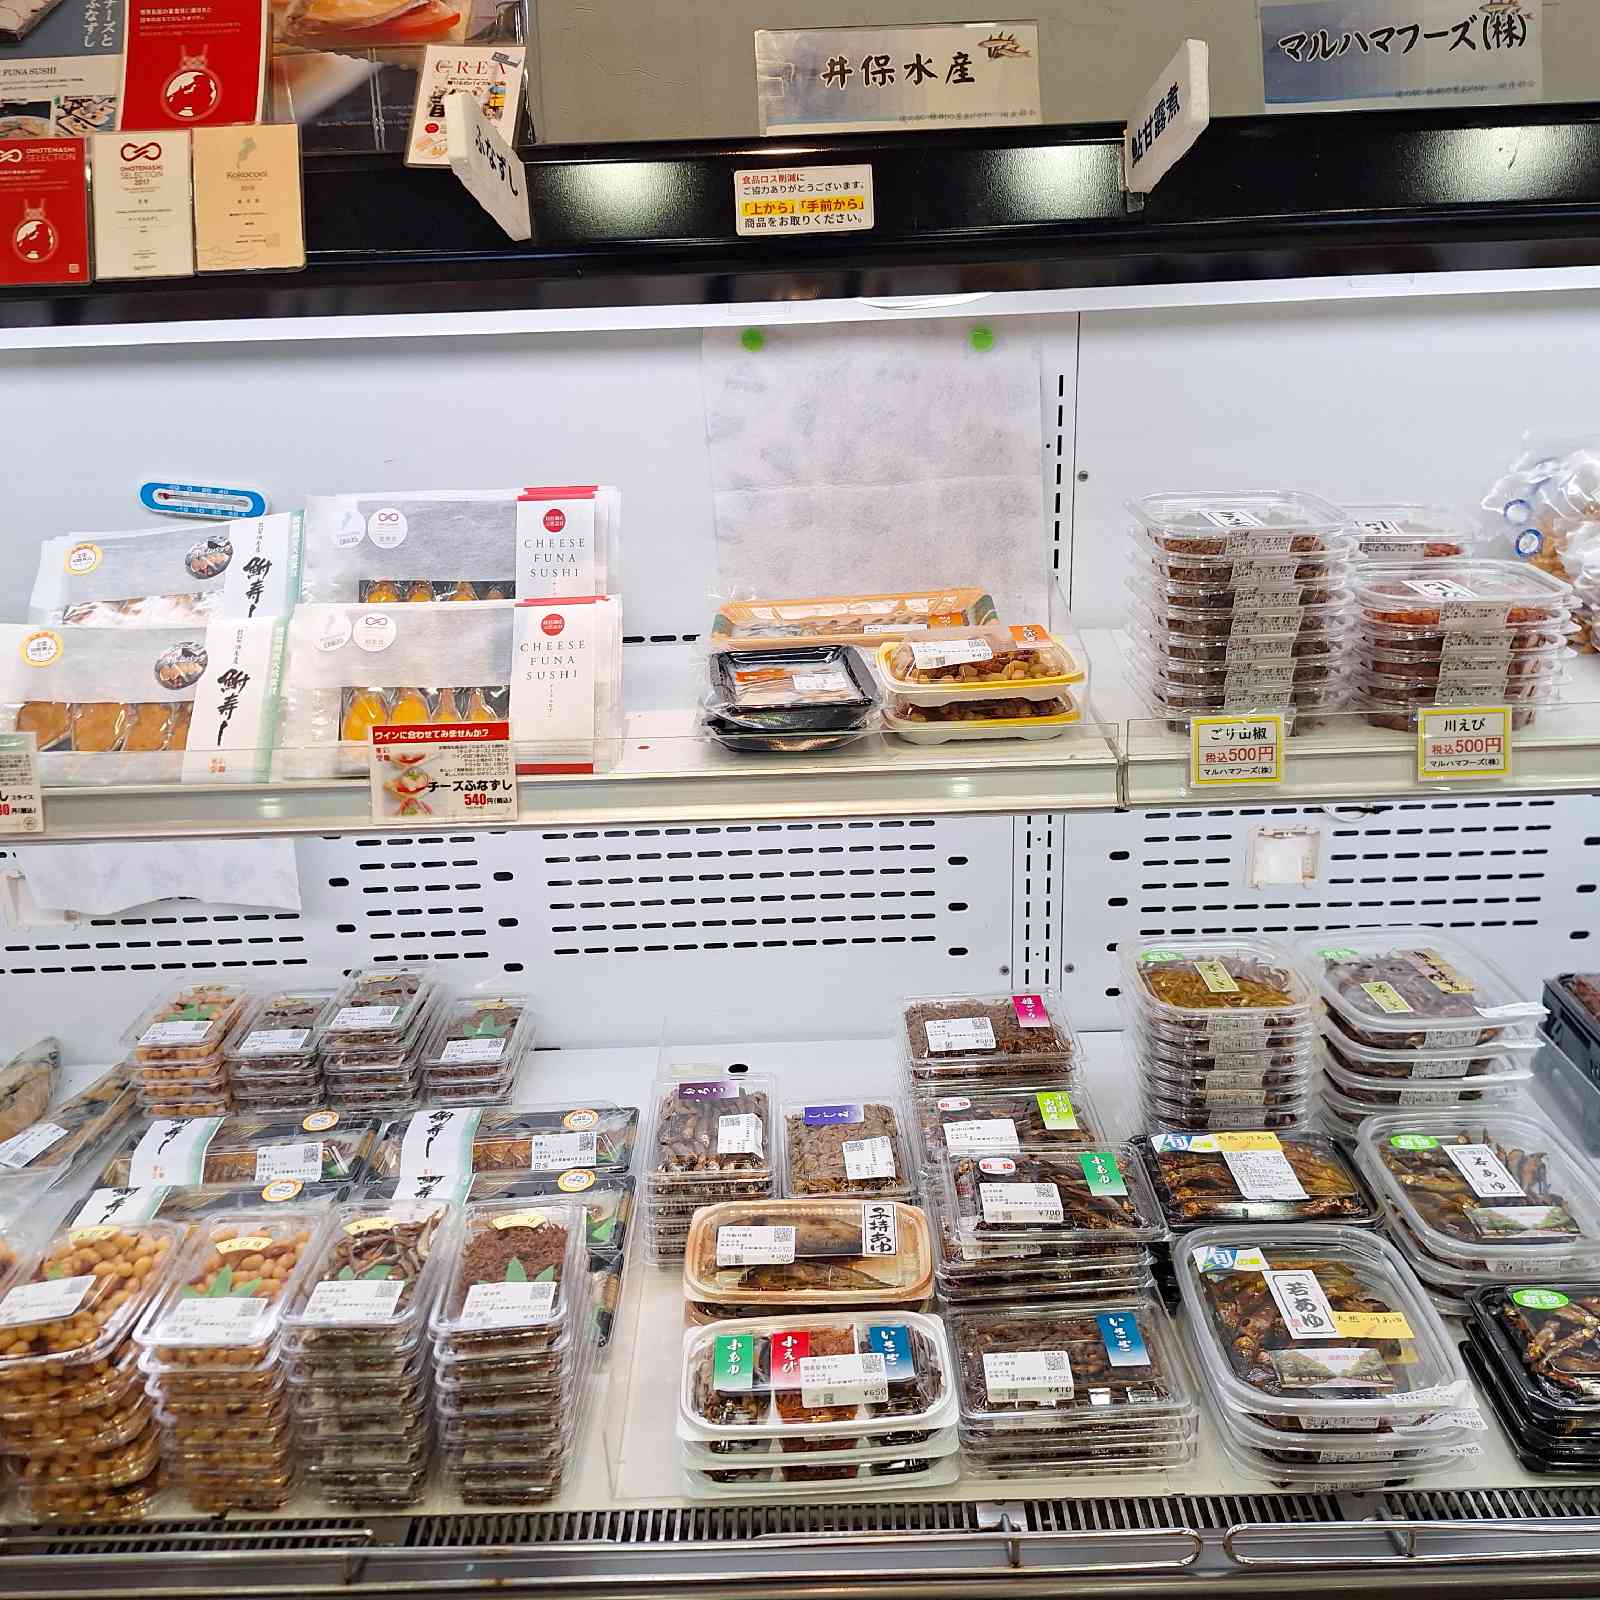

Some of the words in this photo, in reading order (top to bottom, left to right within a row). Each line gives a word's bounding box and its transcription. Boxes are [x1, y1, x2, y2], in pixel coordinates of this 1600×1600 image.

[1278, 13, 1528, 62] マルハマフーズ(株)
[822, 51, 977, 89] 井保水産
[26, 154, 76, 162] SELECTION
[742, 173, 805, 185] 食品ロス削減に
[745, 214, 863, 229] 商品をお取りください。
[524, 538, 585, 549] CHEESE
[534, 553, 576, 563] FUNA
[530, 568, 578, 578] SUSHI
[520, 640, 586, 653] CHEESE
[530, 655, 575, 666] FUNA
[526, 670, 577, 681] SUSHI
[1444, 717, 1486, 733] 川えび
[1210, 726, 1267, 740] ごり山椒
[1431, 737, 1502, 755] 税込500円
[1206, 746, 1274, 763] 税込500円
[1430, 758, 1500, 768] マルハマフーズ(株)
[1203, 766, 1273, 776] マルハマフーズ(株)
[428, 779, 513, 793] チーズふなずし
[868, 1206, 893, 1253] 子持あゆ
[1284, 1280, 1325, 1330] 若あゆ
